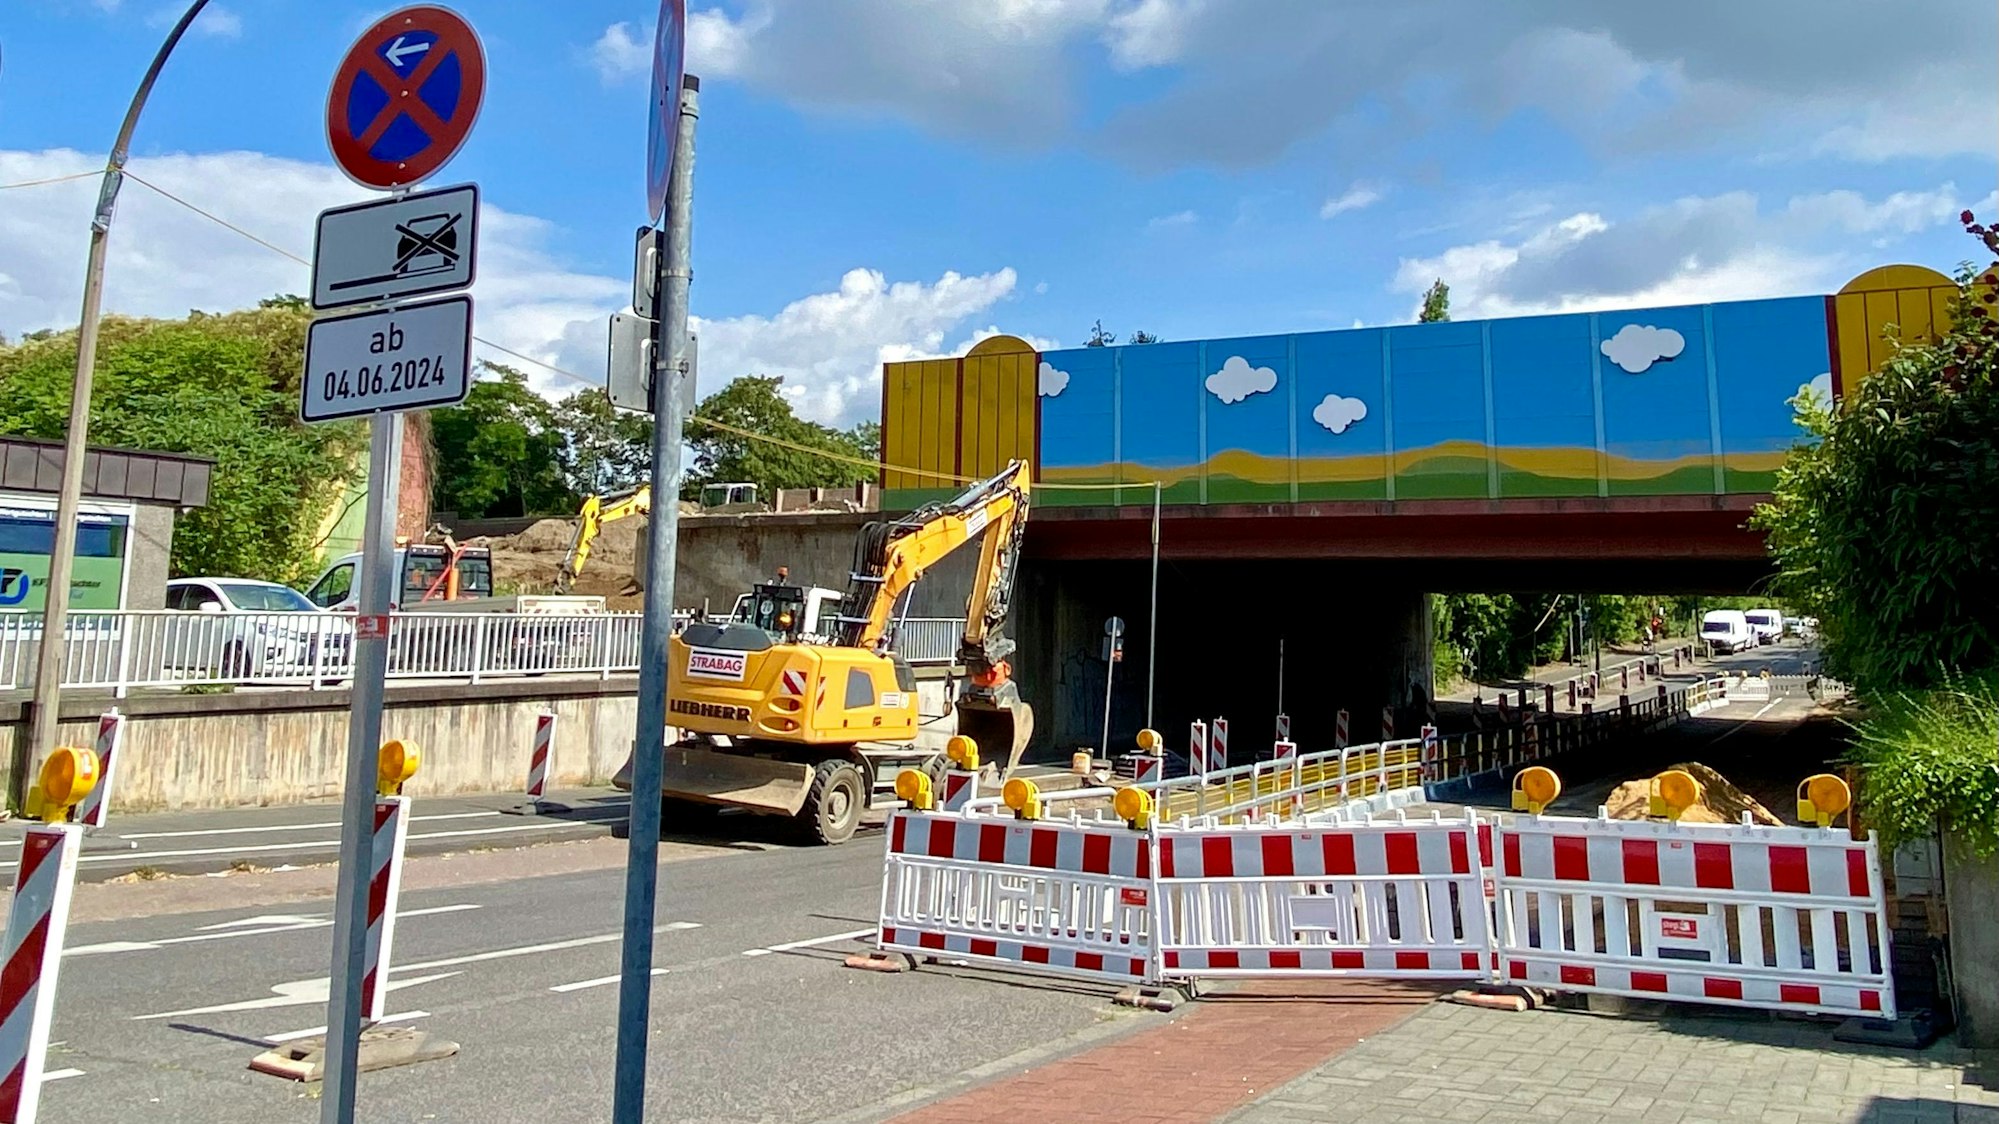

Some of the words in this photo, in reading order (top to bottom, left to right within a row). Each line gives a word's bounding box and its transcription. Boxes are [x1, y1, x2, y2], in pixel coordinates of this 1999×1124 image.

[370, 322, 404, 354] ab
[324, 355, 445, 402] 04.06.2024
[690, 655, 743, 672] STRABAG
[670, 699, 752, 722] LIEBHERR
